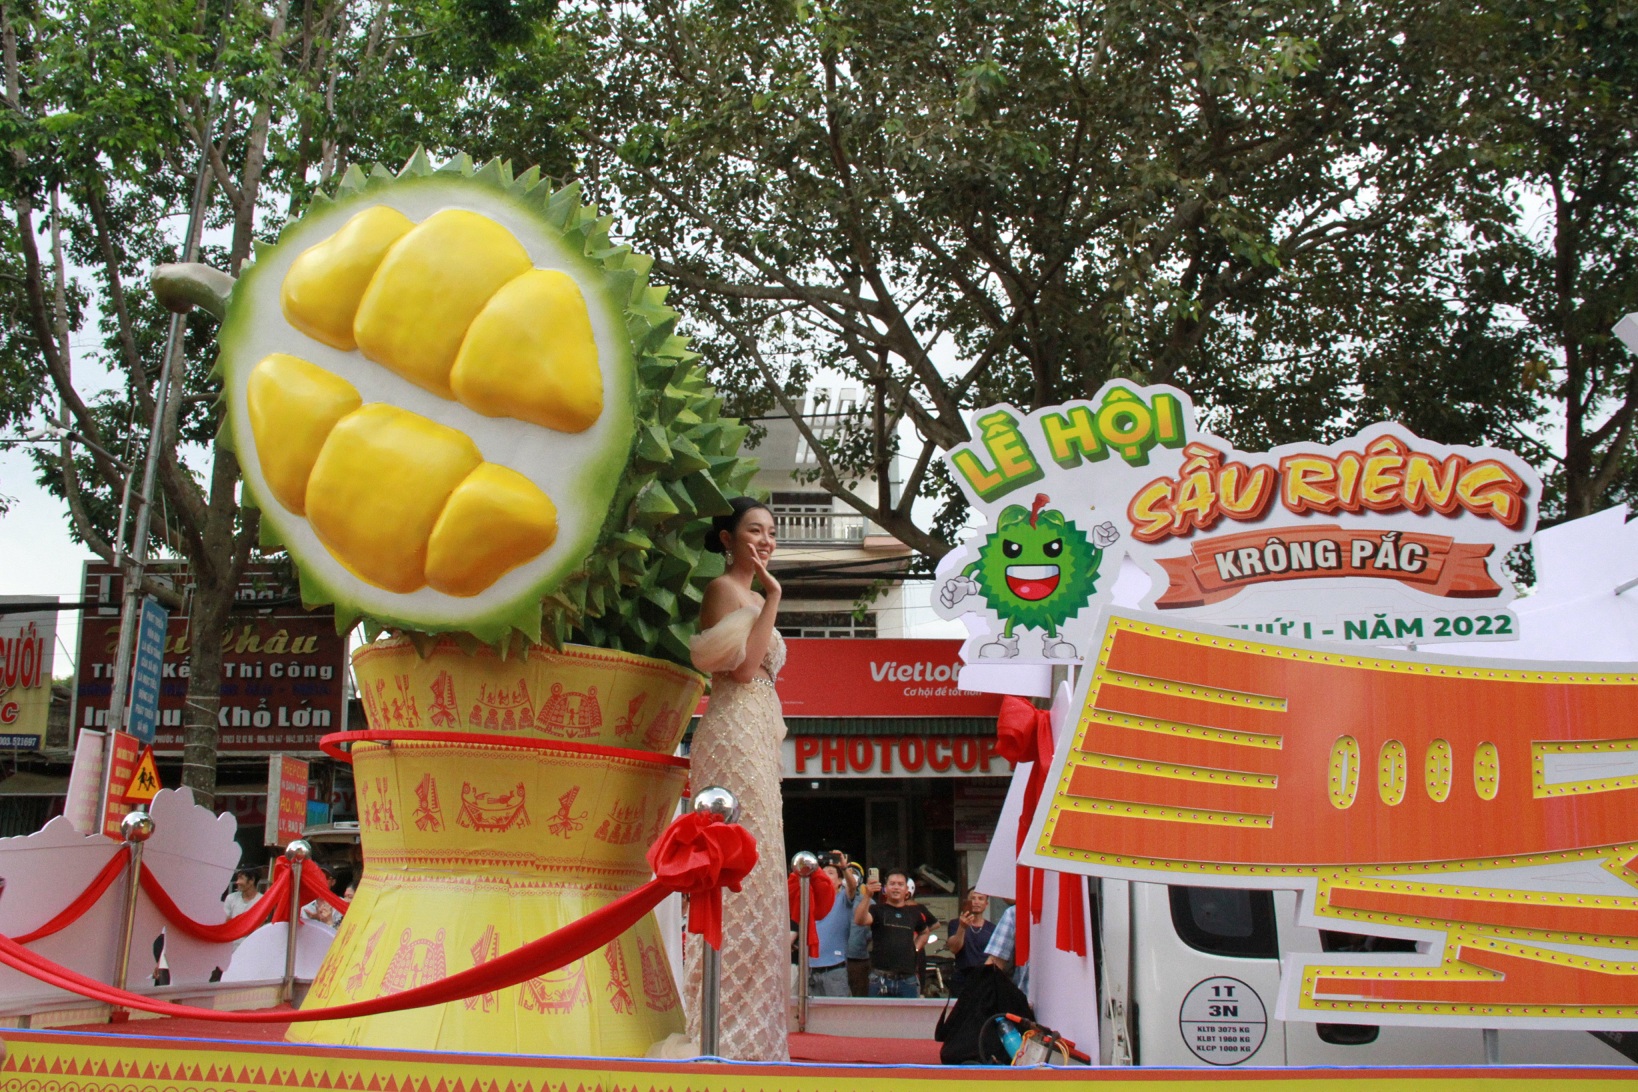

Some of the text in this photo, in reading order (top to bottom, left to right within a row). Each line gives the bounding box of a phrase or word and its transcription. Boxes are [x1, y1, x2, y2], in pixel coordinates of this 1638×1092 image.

[951, 386, 1187, 503] LỄ HỘI
[1127, 434, 1524, 542] SẦU RIÊNG
[1214, 532, 1430, 582] KRÔNG PẮC
[1344, 613, 1424, 640] NĂM
[1433, 615, 1513, 637] 2022
[224, 661, 262, 678] Thi
[269, 661, 333, 680] Công
[918, 687, 933, 698] hội
[278, 699, 331, 728] Lớn
[795, 735, 1015, 773] PHOTOCOP
[1208, 1005, 1238, 1017] 3N
